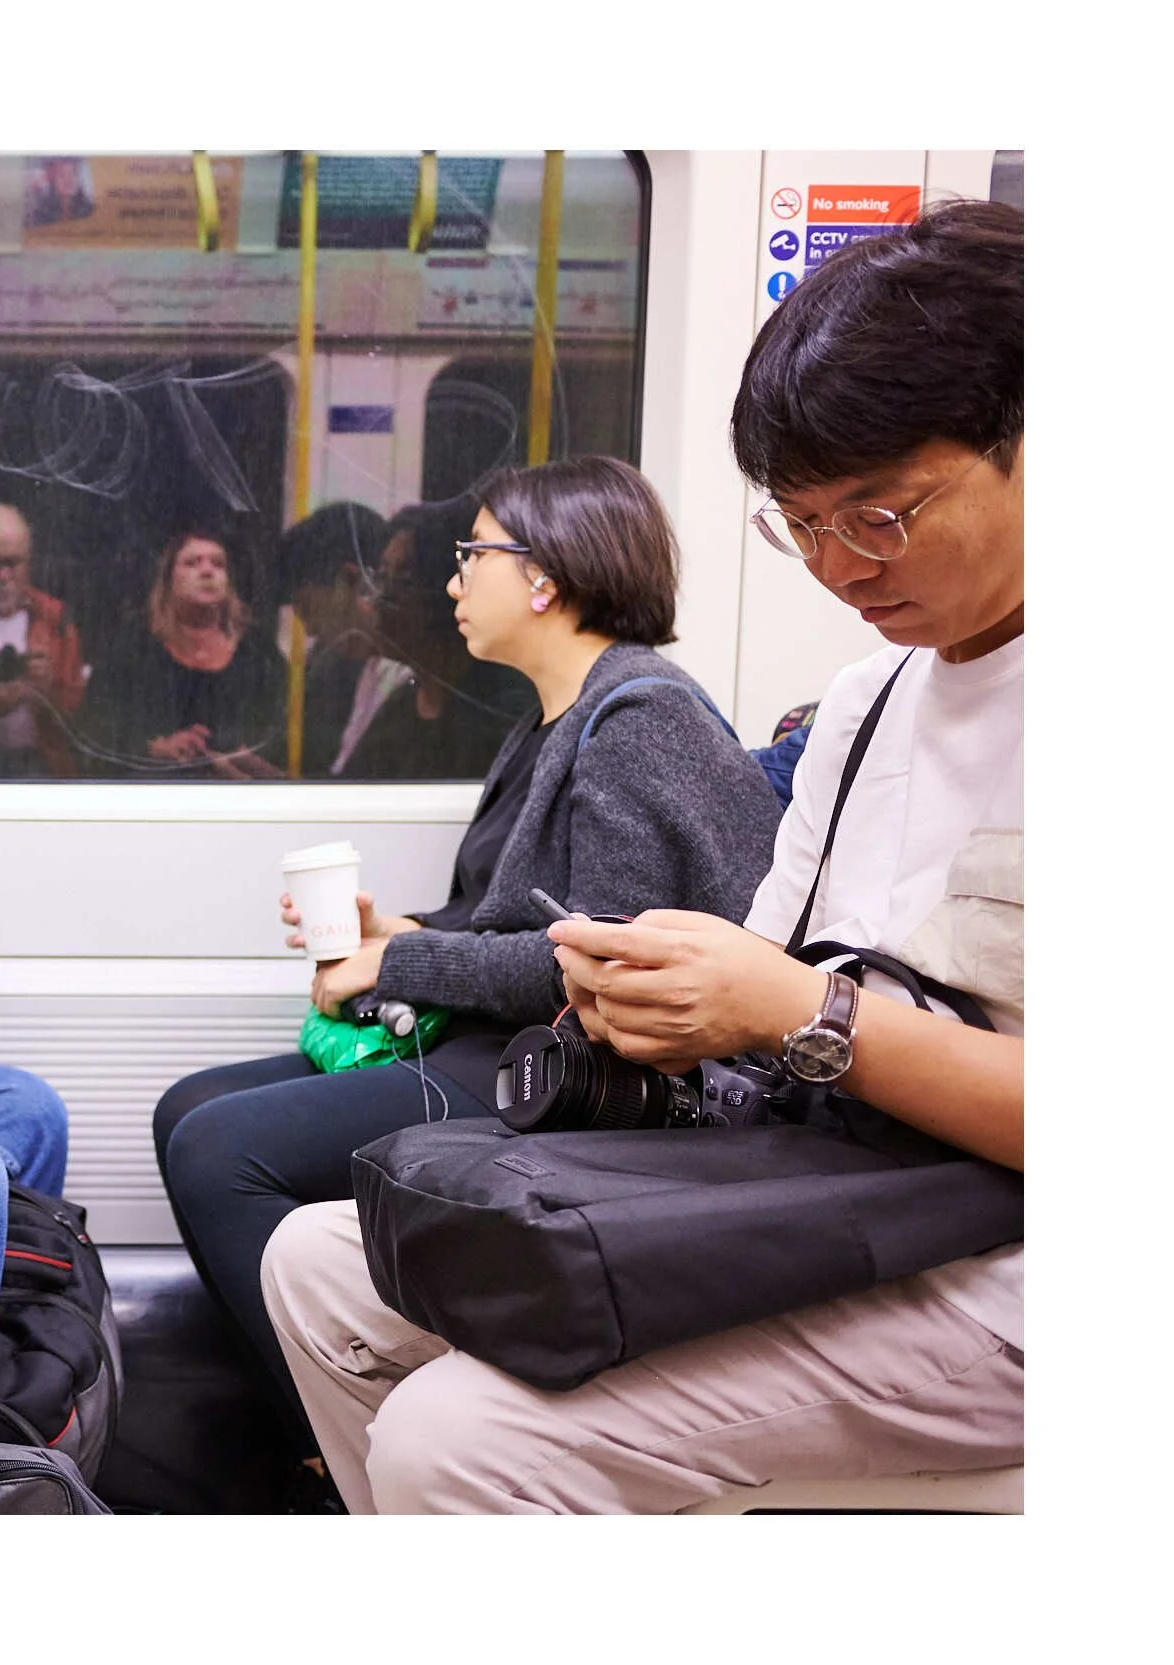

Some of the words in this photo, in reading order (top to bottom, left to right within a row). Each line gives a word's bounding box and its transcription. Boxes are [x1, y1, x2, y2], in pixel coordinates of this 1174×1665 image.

[813, 197, 834, 211] No
[836, 197, 890, 213] smoking
[810, 231, 848, 245] CCTV
[809, 246, 823, 259] in
[310, 922, 358, 939] GAIL
[523, 1053, 533, 1101] Canon
